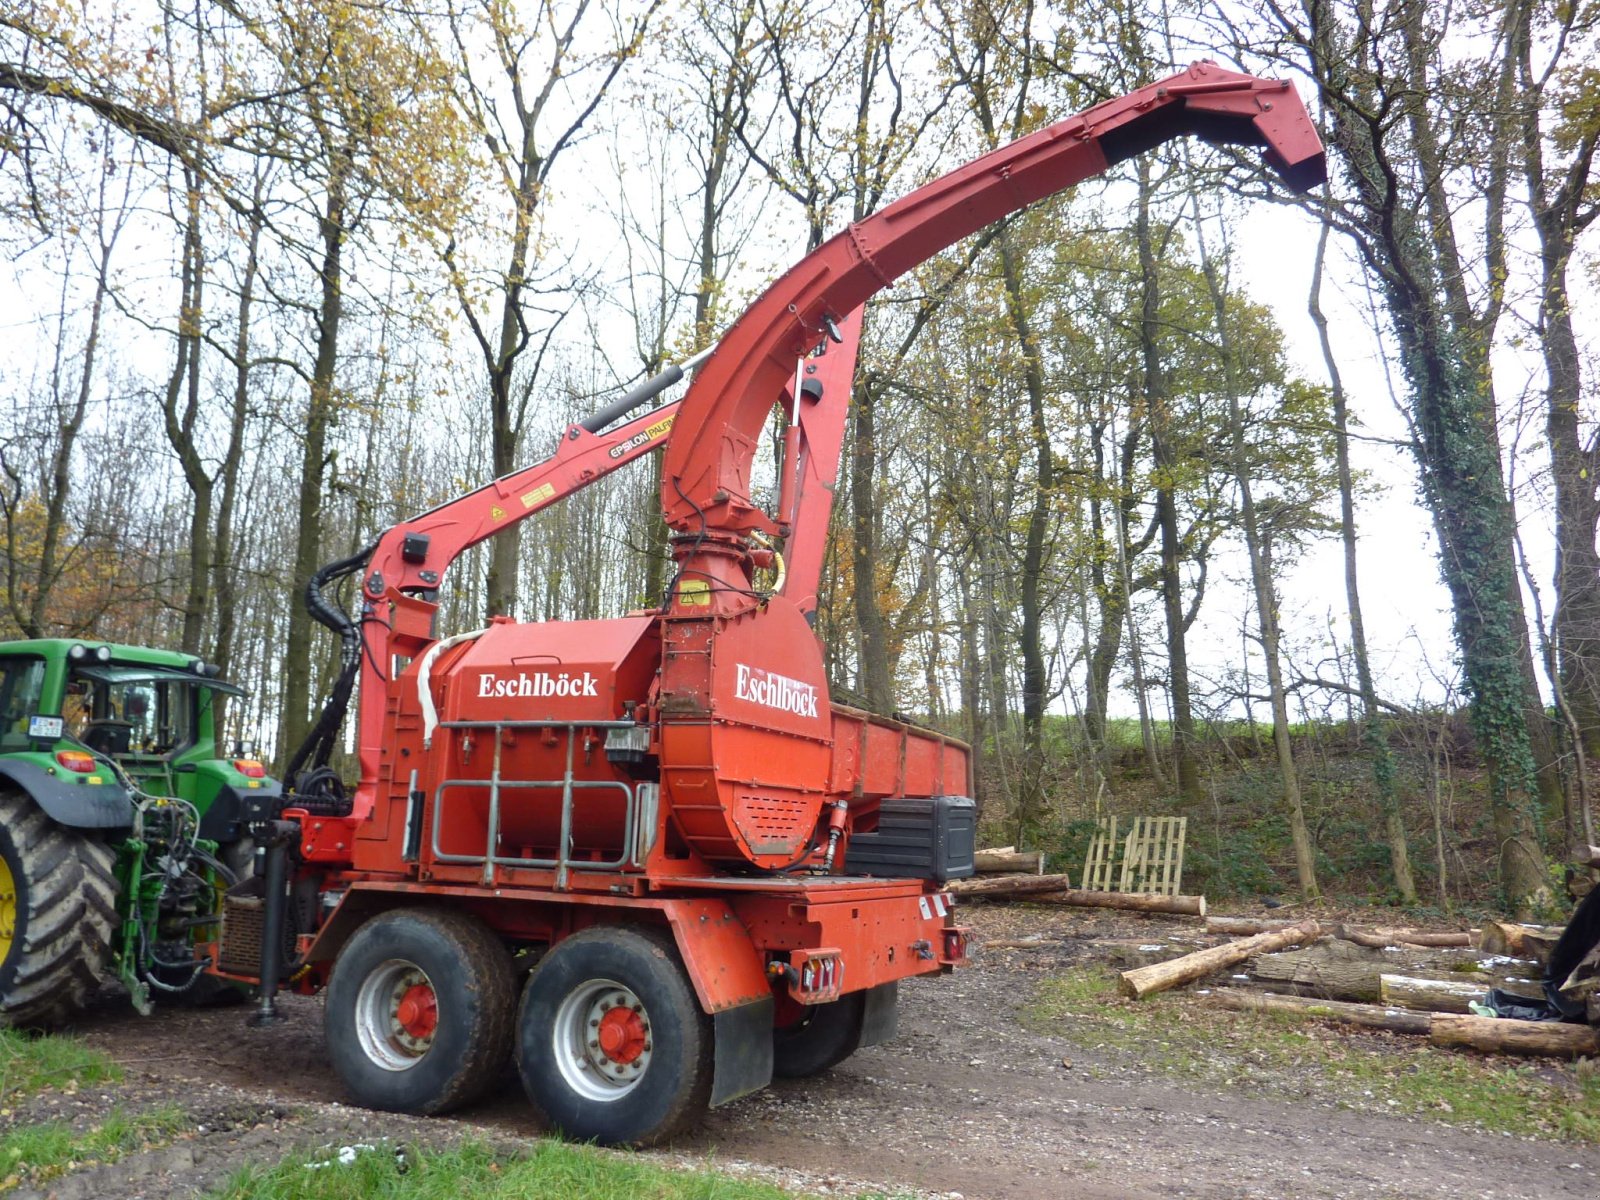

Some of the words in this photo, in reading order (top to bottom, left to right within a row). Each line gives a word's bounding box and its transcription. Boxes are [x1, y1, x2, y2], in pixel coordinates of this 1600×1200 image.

[610, 432, 649, 458] EPSILON
[477, 672, 598, 698] Eschlböck
[734, 663, 818, 718] Eschlböck
